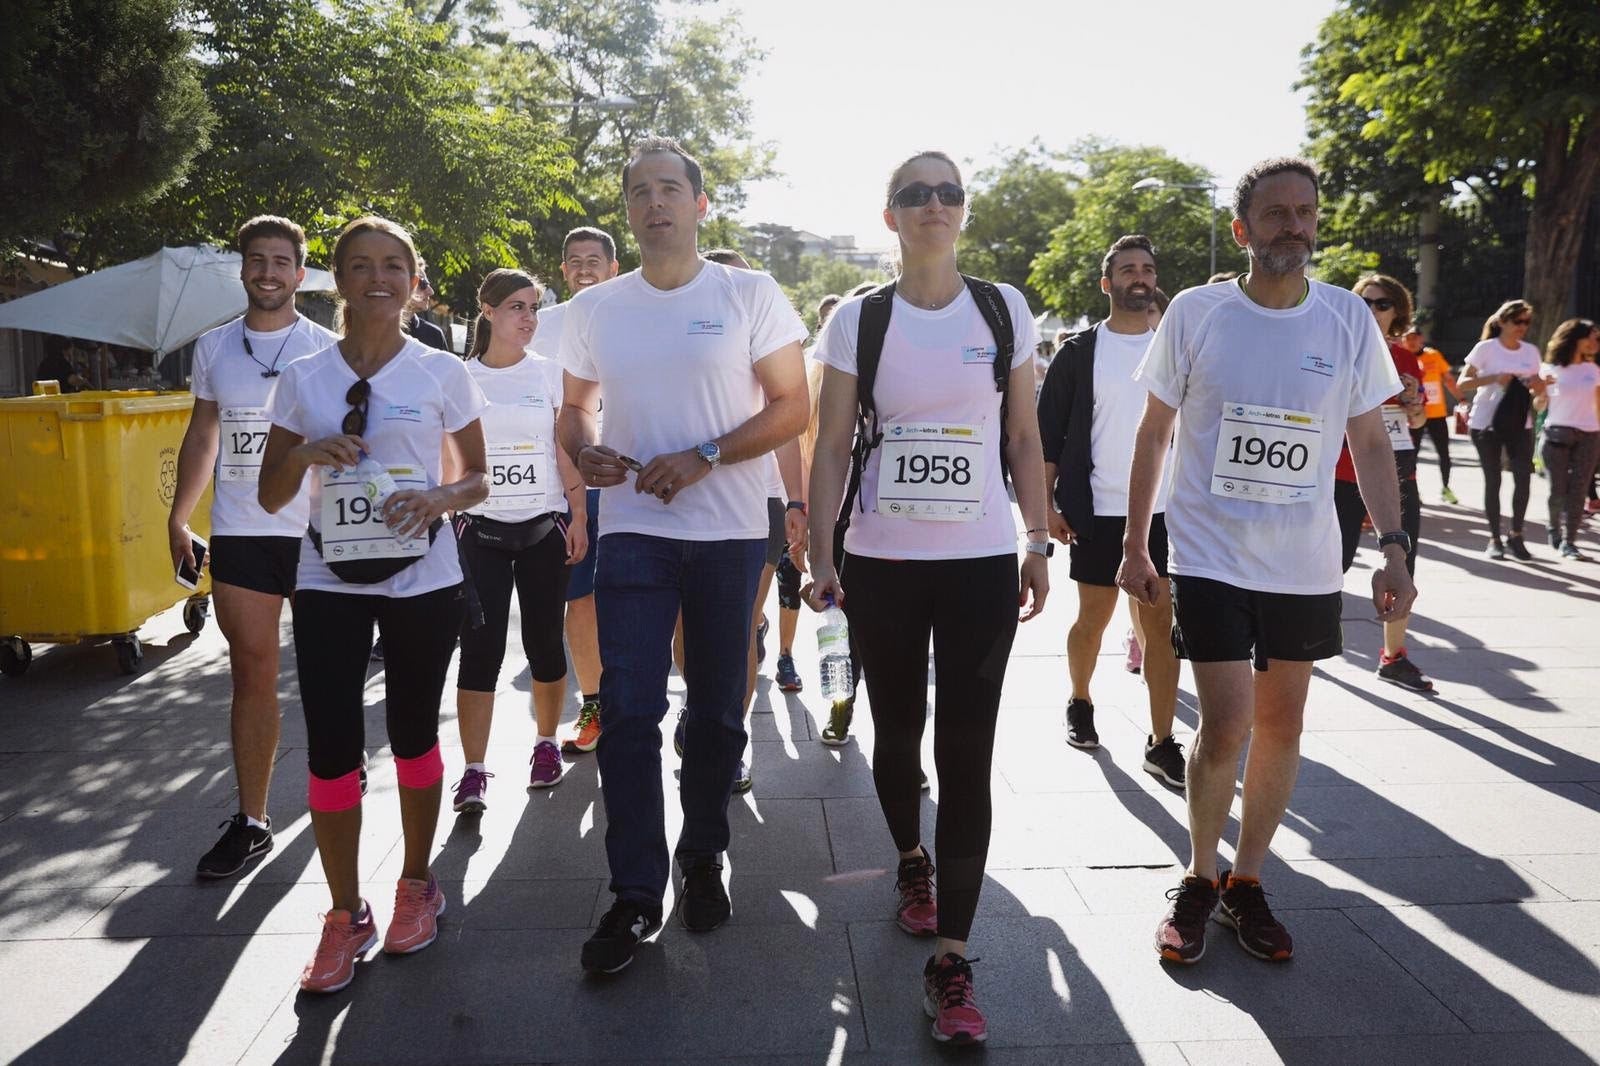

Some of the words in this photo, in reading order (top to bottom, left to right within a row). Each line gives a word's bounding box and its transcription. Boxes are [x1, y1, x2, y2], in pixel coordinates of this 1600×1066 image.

[231, 432, 269, 454] 127
[1228, 435, 1309, 472] 1960
[491, 464, 537, 486] 564
[894, 454, 972, 486] 1958
